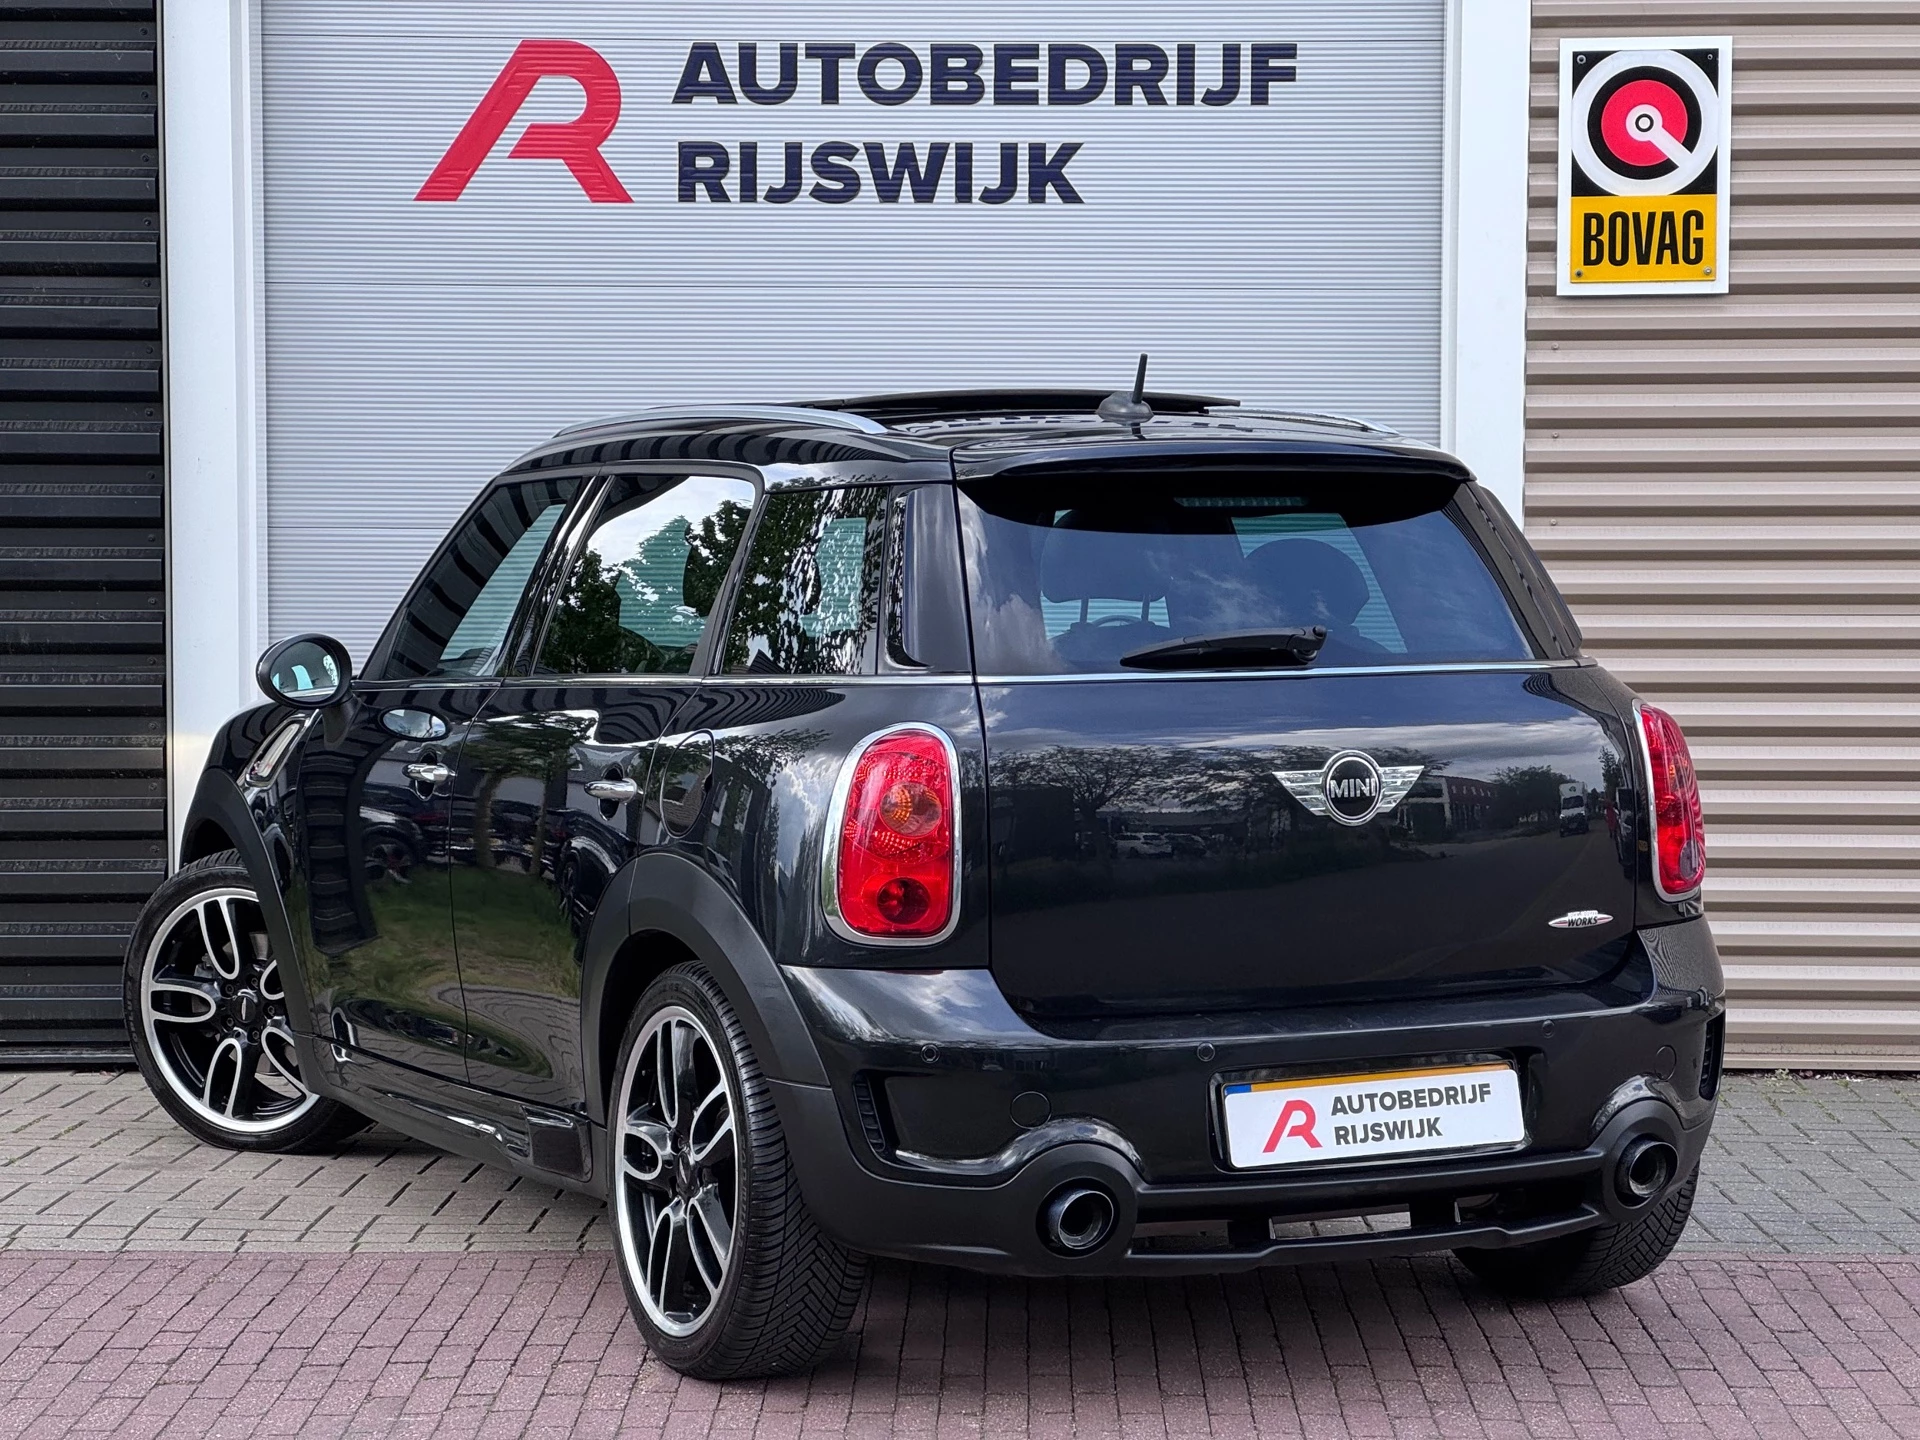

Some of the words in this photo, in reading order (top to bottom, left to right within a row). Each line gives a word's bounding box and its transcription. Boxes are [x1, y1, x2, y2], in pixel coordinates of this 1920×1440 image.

[671, 42, 1298, 106] AUTOBEDRIJF
[678, 140, 1085, 204] RIJSWIJK
[1583, 210, 1704, 266] BOVAG
[1330, 778, 1376, 798] MINI
[1567, 916, 1598, 927] WORKS
[1331, 1083, 1492, 1116] AUTOBEDRIJF
[1334, 1117, 1443, 1146] RIJSWIJK
